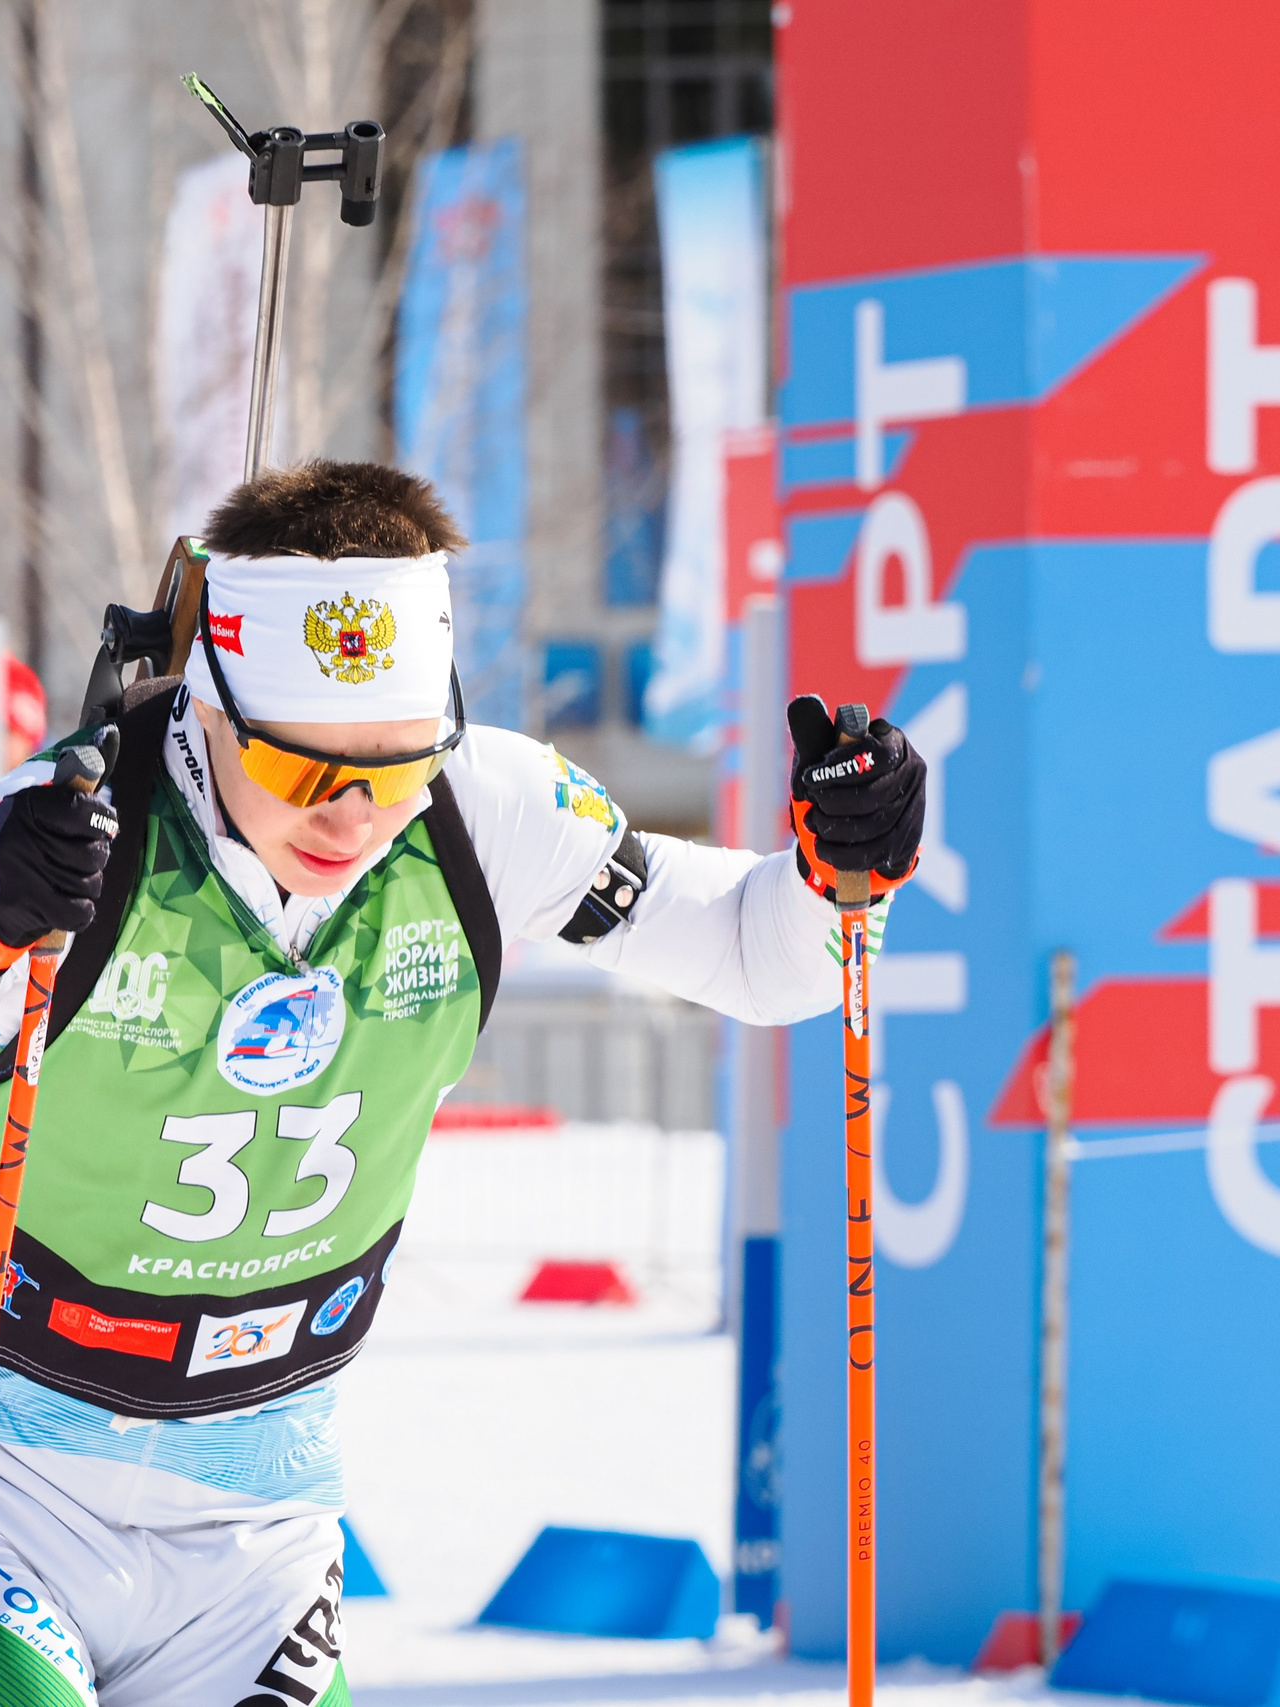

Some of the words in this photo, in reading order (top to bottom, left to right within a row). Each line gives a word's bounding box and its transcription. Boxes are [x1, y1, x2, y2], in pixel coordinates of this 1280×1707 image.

[811, 751, 875, 782] KINETIXX
[385, 919, 444, 950] СПОРТ
[385, 939, 459, 974] НОРМА
[153, 971, 171, 981] ЛЕТ
[384, 961, 459, 996] ЖИЗНИ
[235, 974, 306, 1008] ПЕРВЕН
[383, 982, 457, 1009] ФЕДЕРАЛЬНЫЙ
[71, 1015, 142, 1033] ИНИСТЕРСТВО
[144, 1028, 180, 1038] СПОРТА
[383, 1003, 420, 1021] ПРОЕКТ
[65, 1024, 120, 1040] ОССИЙСКОЙ
[123, 1033, 182, 1049] ФЕДЕРАЦИИ
[140, 1091, 362, 1242] 33
[127, 1235, 338, 1280] КРАСНОЯРСК
[88, 1321, 115, 1333] КРАЙ
[90, 1314, 173, 1334] КРАСНОЯРСКИЙ
[858, 1438, 872, 1465] 40
[858, 1476, 872, 1562] PREMIO
